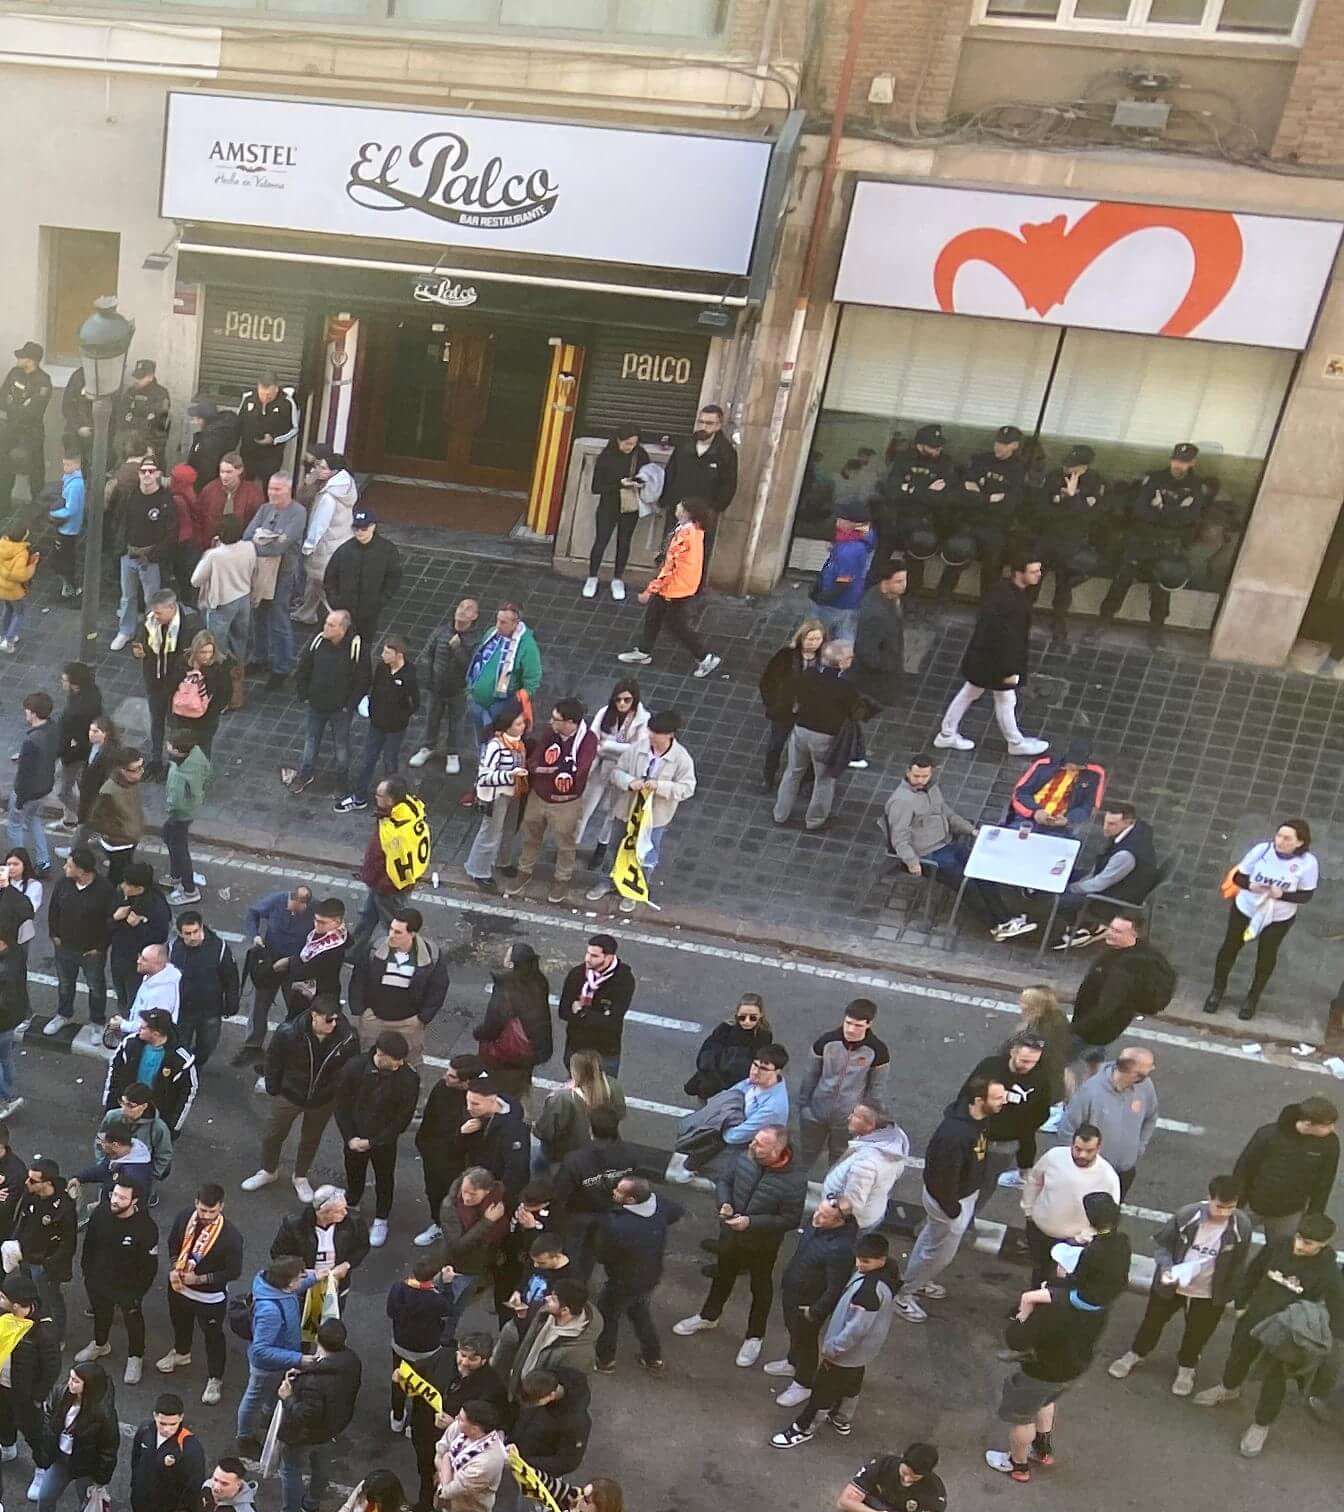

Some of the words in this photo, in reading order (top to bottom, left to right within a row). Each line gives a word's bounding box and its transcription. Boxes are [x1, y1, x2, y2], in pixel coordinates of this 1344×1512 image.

[208, 141, 296, 166] AMSTEL
[348, 142, 401, 188] El
[410, 132, 559, 211] Palco
[459, 212, 478, 227] BAR
[478, 204, 549, 229] RESTAURANTE
[408, 1373, 438, 1402] LIM
